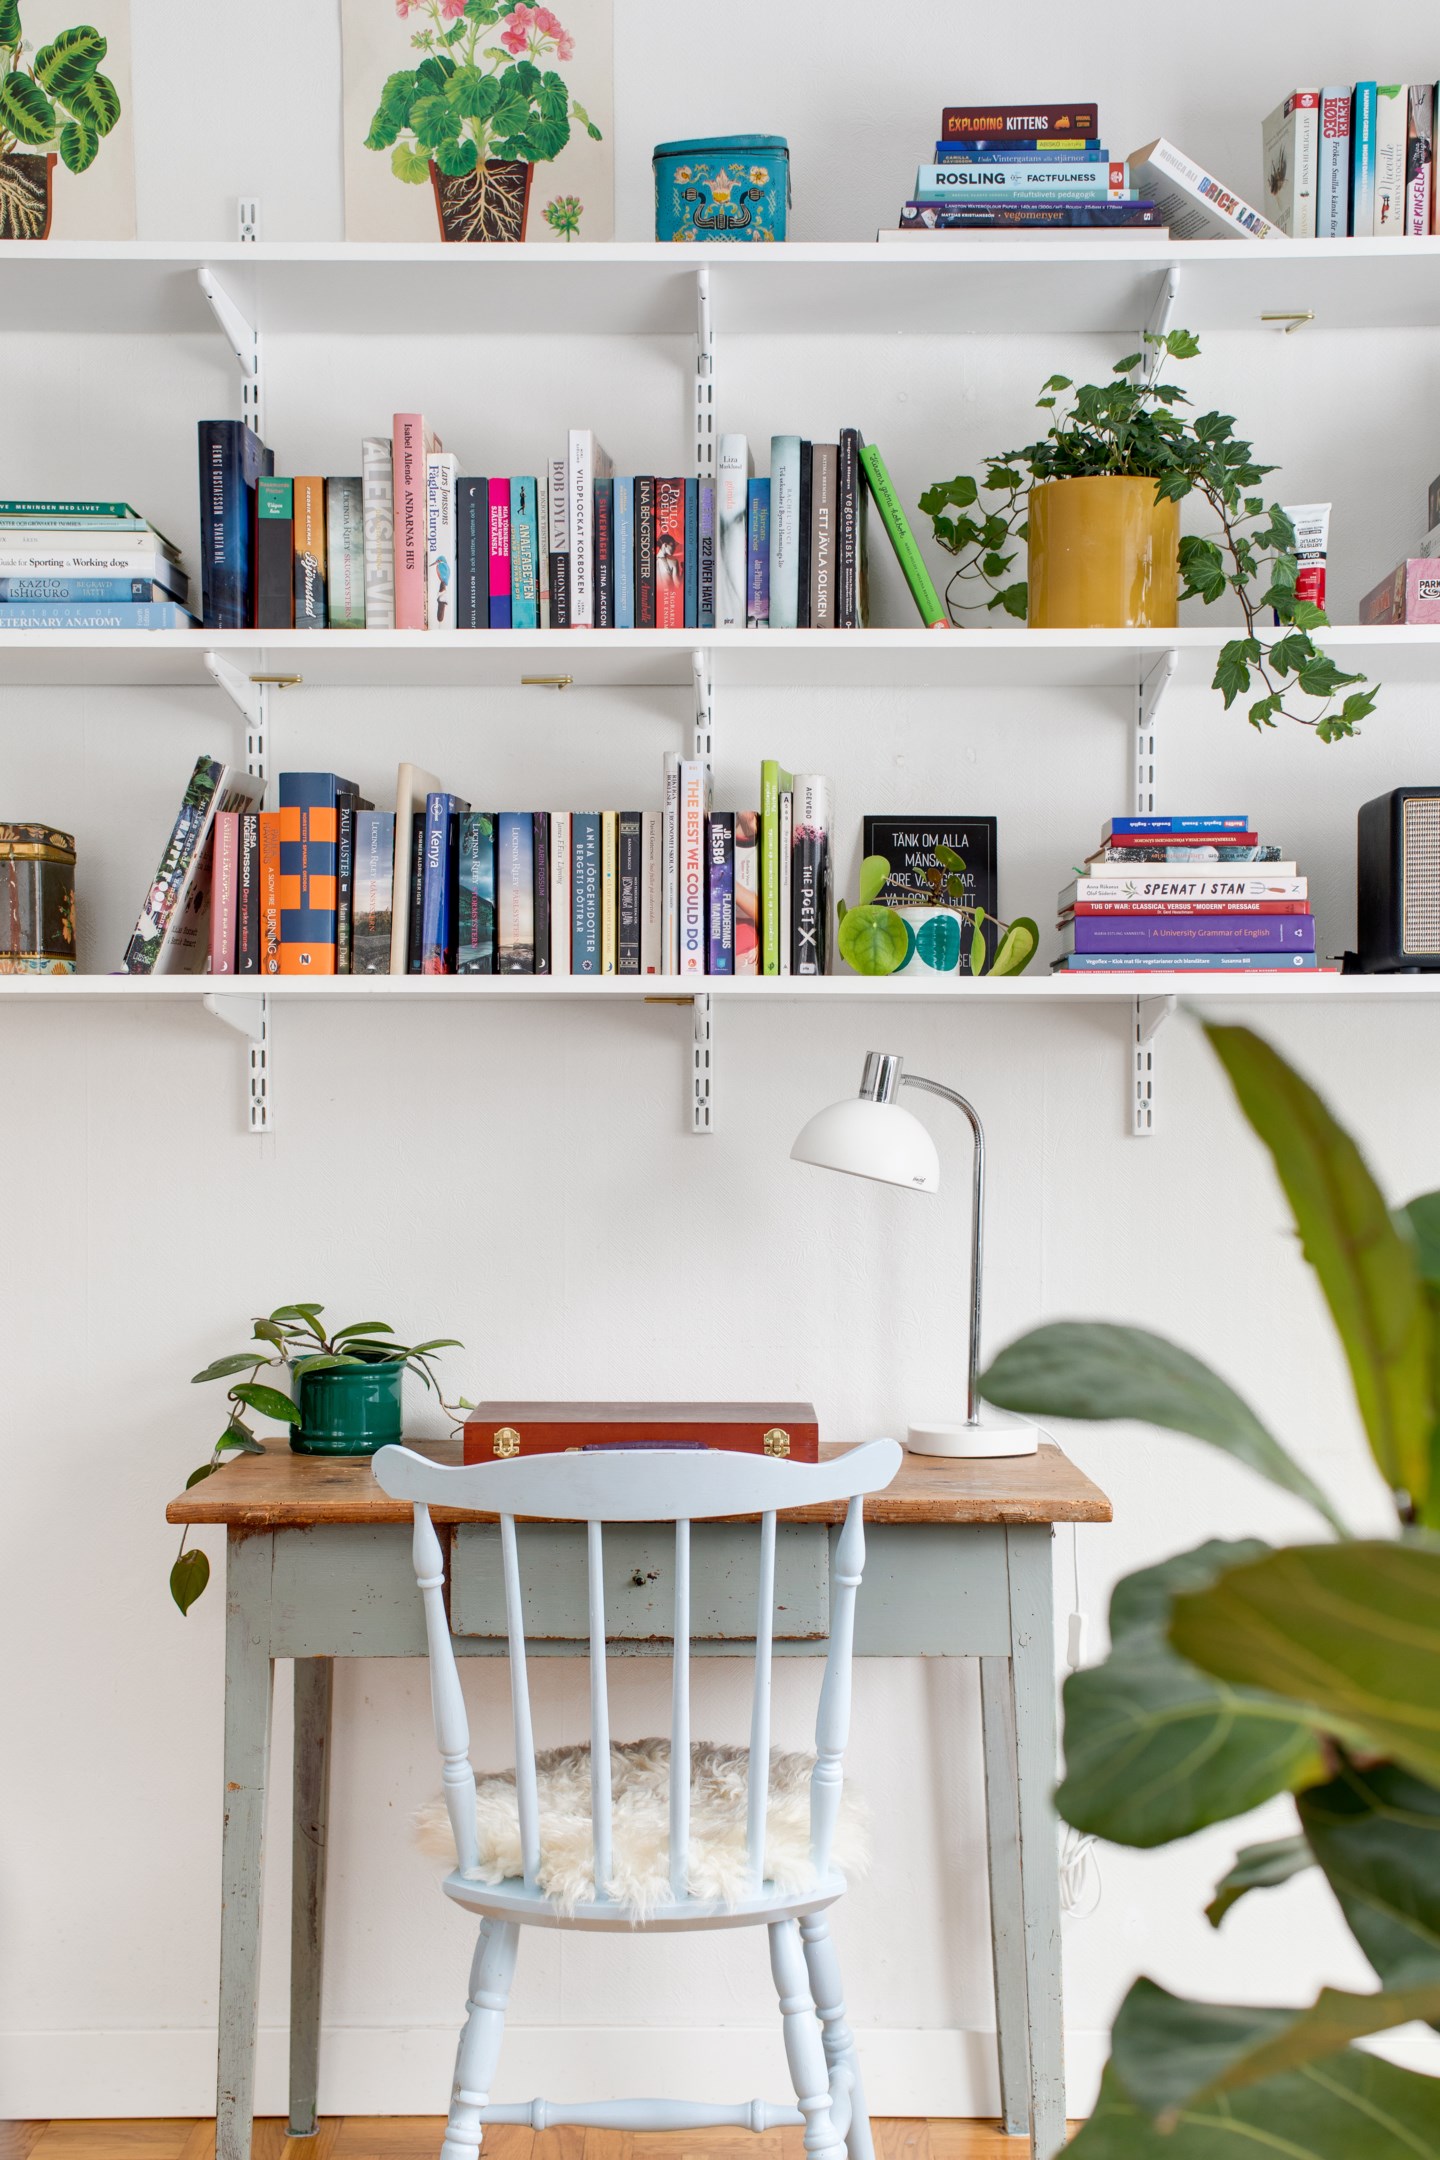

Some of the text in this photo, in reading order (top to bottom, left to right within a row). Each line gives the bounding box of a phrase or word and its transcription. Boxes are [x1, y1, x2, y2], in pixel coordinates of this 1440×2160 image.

[948, 116, 1049, 132] EXPLODING KITTENS
[1323, 97, 1337, 139] HØEG
[1337, 97, 1349, 138] PETER
[935, 173, 1006, 185] ROSLING
[1026, 173, 1096, 182] FACTFULNESS
[1054, 154, 1085, 163] stjärnor
[1159, 149, 1187, 174] MONICA
[1330, 141, 1341, 218] Fröken Smillas känsla
[1012, 191, 1056, 199] Friluftslivets
[1058, 191, 1096, 201] pedagogik
[1394, 144, 1403, 221] KATHRYN STOCKETT
[1413, 167, 1425, 217] KINSELLA
[1197, 176, 1239, 216] BRICK
[1235, 207, 1271, 239] LANE
[212, 444, 223, 515] BENGT GUSTAFSSON
[404, 423, 415, 570] Isabel Allende ANDARNAS HUS
[440, 465, 450, 525] Lars Jonssons
[878, 486, 893, 508] gröna
[427, 465, 439, 552] Fåglar Europa
[552, 461, 566, 550] BOB DYLAN
[660, 483, 672, 534] COELHO
[668, 489, 680, 529] PAULO
[213, 523, 226, 565] SVARTA HÅL
[490, 505, 498, 556] SJÄLVKÄNSLA
[576, 469, 585, 595] VILDPLOCKAT KOKBOKEN
[599, 498, 608, 561] SILVERVÄGEN
[640, 481, 651, 579] LINA BENGTSDOTTER
[844, 492, 854, 565] vegetariskt
[29, 558, 64, 568] Sporting
[72, 558, 108, 568] Working
[109, 558, 129, 568] dogs
[342, 489, 352, 619] LUCINDA RILEY SKUGGSYSTERN
[519, 524, 534, 600] ANALFABETEN
[702, 536, 715, 614] 1222 ÖVER HAVET
[817, 508, 830, 618] ETT JÄVLA SOLSKEN
[10, 588, 69, 598] ISHIGURO
[19, 580, 61, 588] KAZUO
[301, 552, 318, 618] Björnstad
[556, 556, 566, 624] CHRONICLES
[641, 581, 652, 623] Annabelle
[65, 617, 122, 627] ANATOMY
[600, 590, 608, 627] JACKSON
[805, 786, 813, 820] ACEVEDO
[166, 820, 190, 870] HAPPY
[340, 808, 350, 878] PAUL AUSTER
[370, 821, 380, 854] LUCINDA
[427, 830, 442, 868] Kenya
[712, 824, 725, 865] NESBØ
[723, 828, 732, 840] JO
[892, 832, 969, 848] TÄNK OM ALLA
[369, 855, 379, 878] RILEY
[510, 826, 521, 887] LUCINDA RILEY
[686, 779, 699, 951] THE BEST WE COULD DO
[803, 865, 813, 884] THE
[470, 823, 481, 949] LUCINDA RILEY STORMSYSTERN
[576, 843, 585, 933] BERGETS DÖTTRAR
[586, 826, 596, 953] ANNA JÖRGENSDOTTER
[885, 873, 911, 888] VORE
[1144, 883, 1245, 895] SPENAT I STAN
[711, 903, 721, 940] MANNEN
[721, 893, 732, 949] FLADDERMUS
[1227, 902, 1260, 910] DRESSAGE
[267, 908, 276, 954] BURNING
[339, 902, 348, 967] Man in the Dark
[798, 926, 816, 947] X
[1152, 929, 1158, 937] A
[1160, 929, 1197, 939] University
[1197, 929, 1233, 938] Grammar
[1233, 929, 1243, 937] of
[1243, 929, 1270, 940] English
[1142, 958, 1173, 966] vegetarianer
